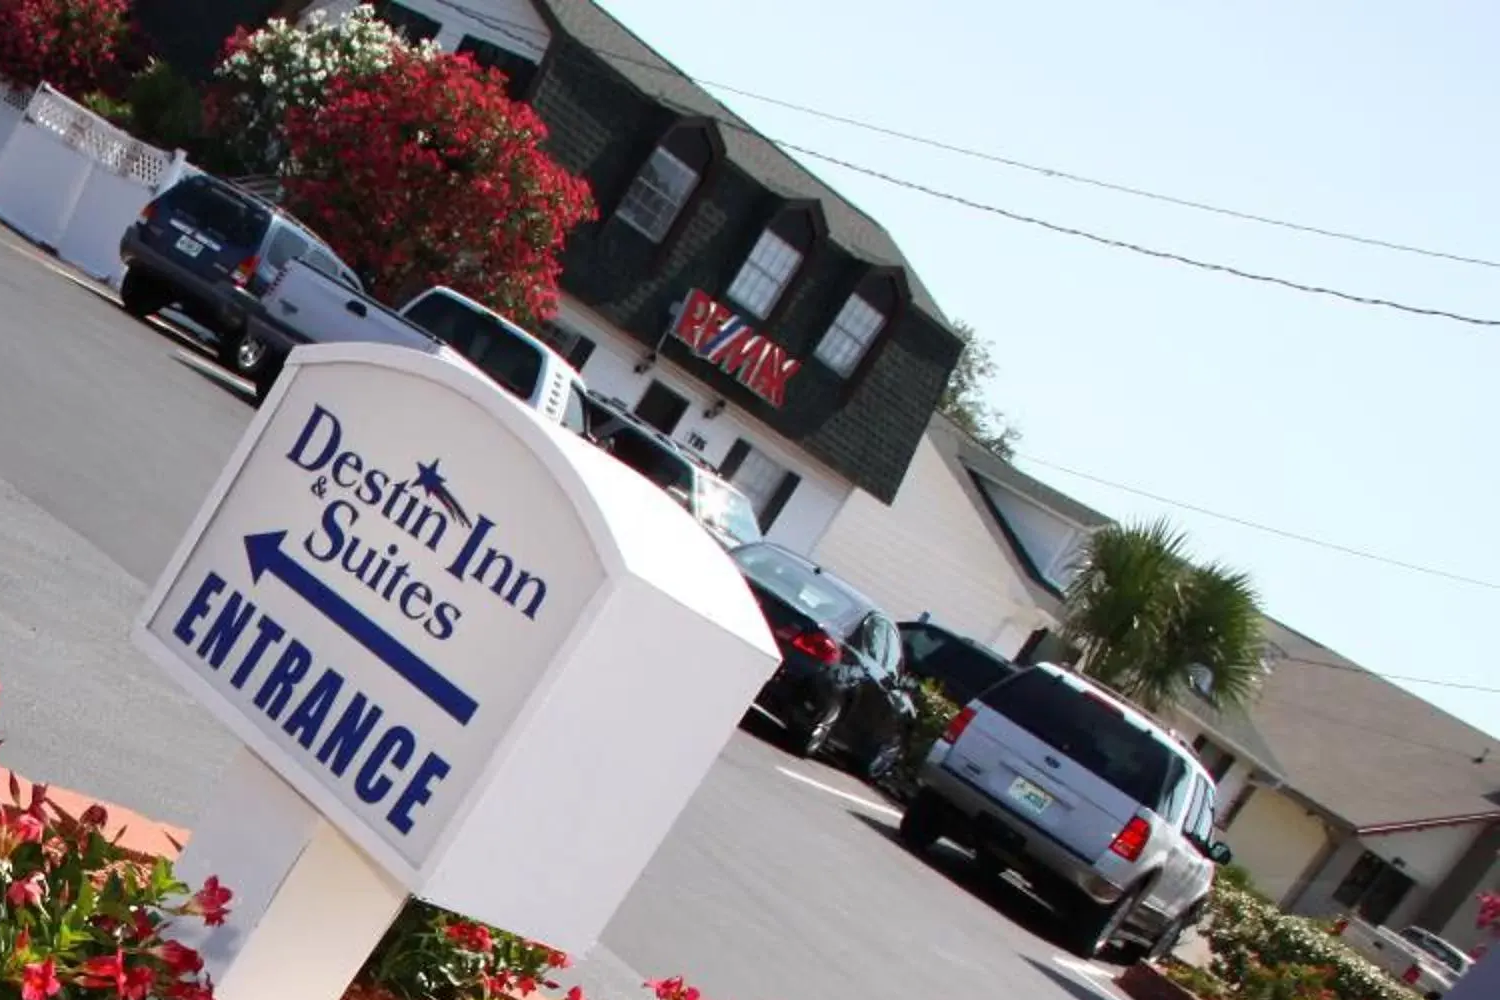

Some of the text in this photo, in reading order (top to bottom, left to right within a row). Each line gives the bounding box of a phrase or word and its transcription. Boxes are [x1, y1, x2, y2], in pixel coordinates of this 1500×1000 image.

[676, 288, 801, 408] RE/MAX
[286, 403, 547, 621] Destin Inn
[303, 475, 463, 641] & Suites
[172, 571, 452, 836] ENTRANCE
